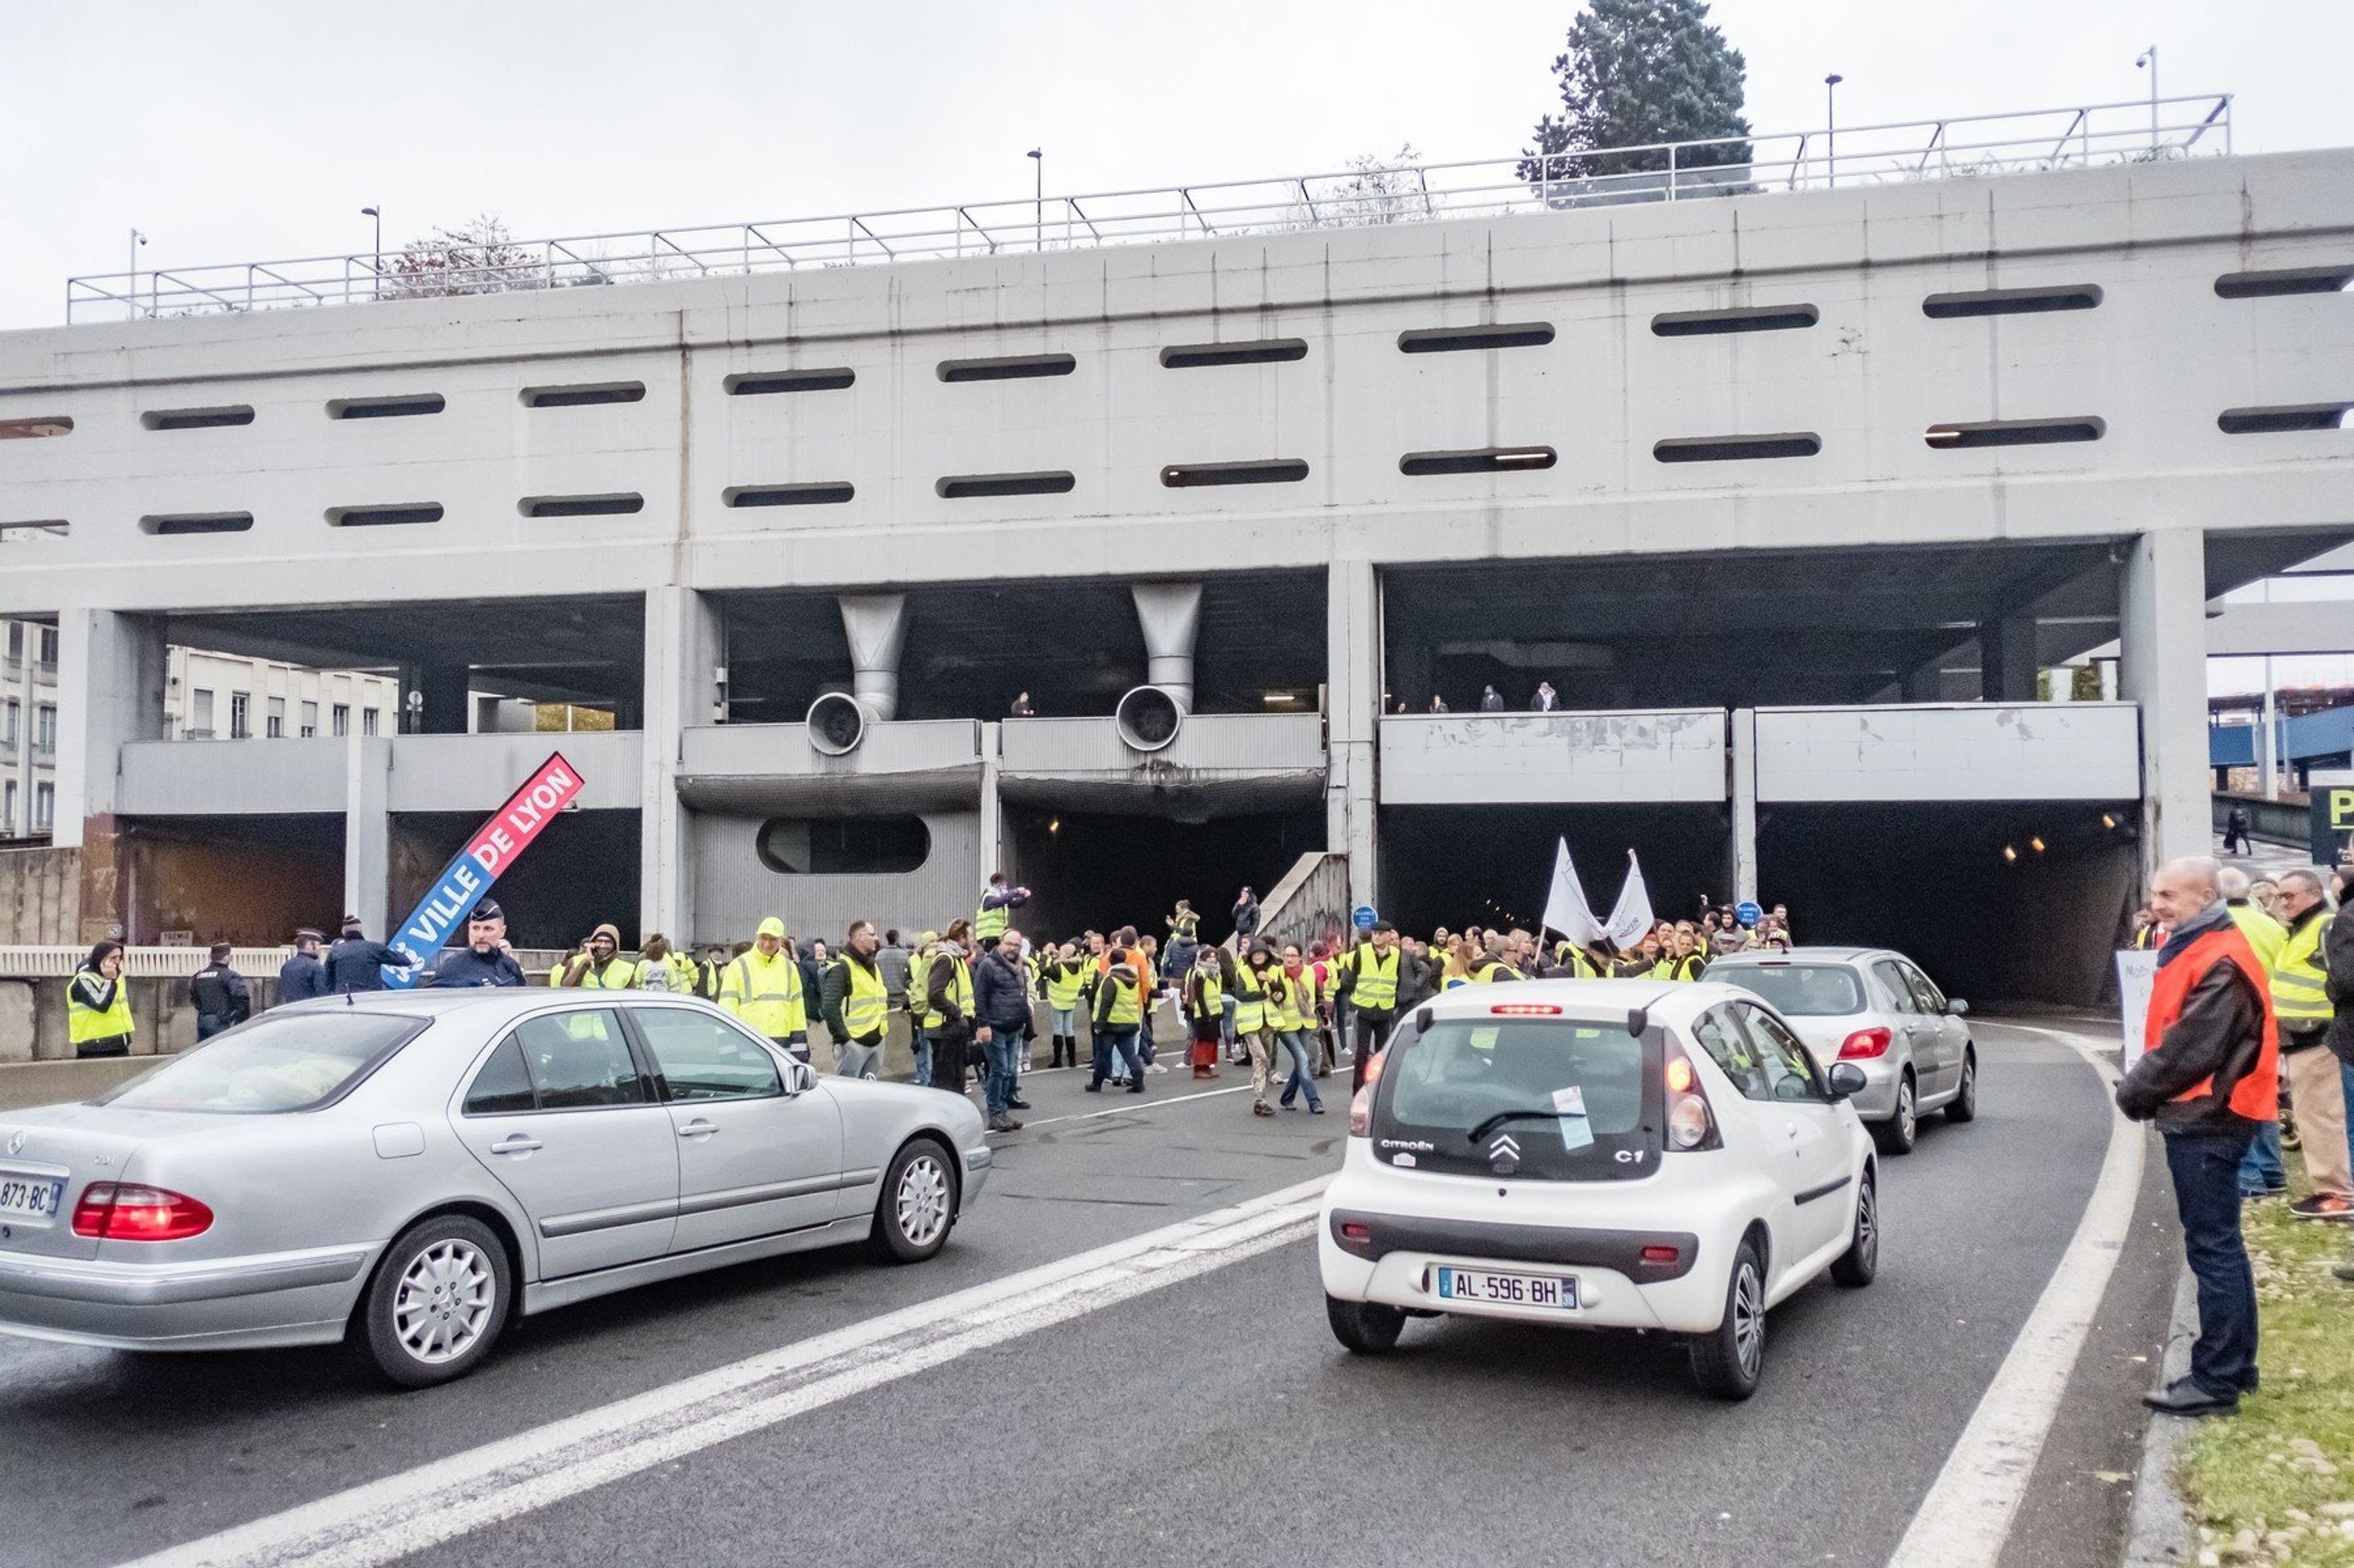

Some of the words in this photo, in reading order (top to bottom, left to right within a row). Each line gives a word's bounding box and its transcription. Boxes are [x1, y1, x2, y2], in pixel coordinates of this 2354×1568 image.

[2331, 790, 2354, 824] P
[408, 864, 480, 942] VILLE
[473, 826, 515, 873] DE
[508, 767, 573, 834] LYON
[1380, 1139, 1434, 1150] CITROËN
[1615, 1150, 1644, 1163] C1
